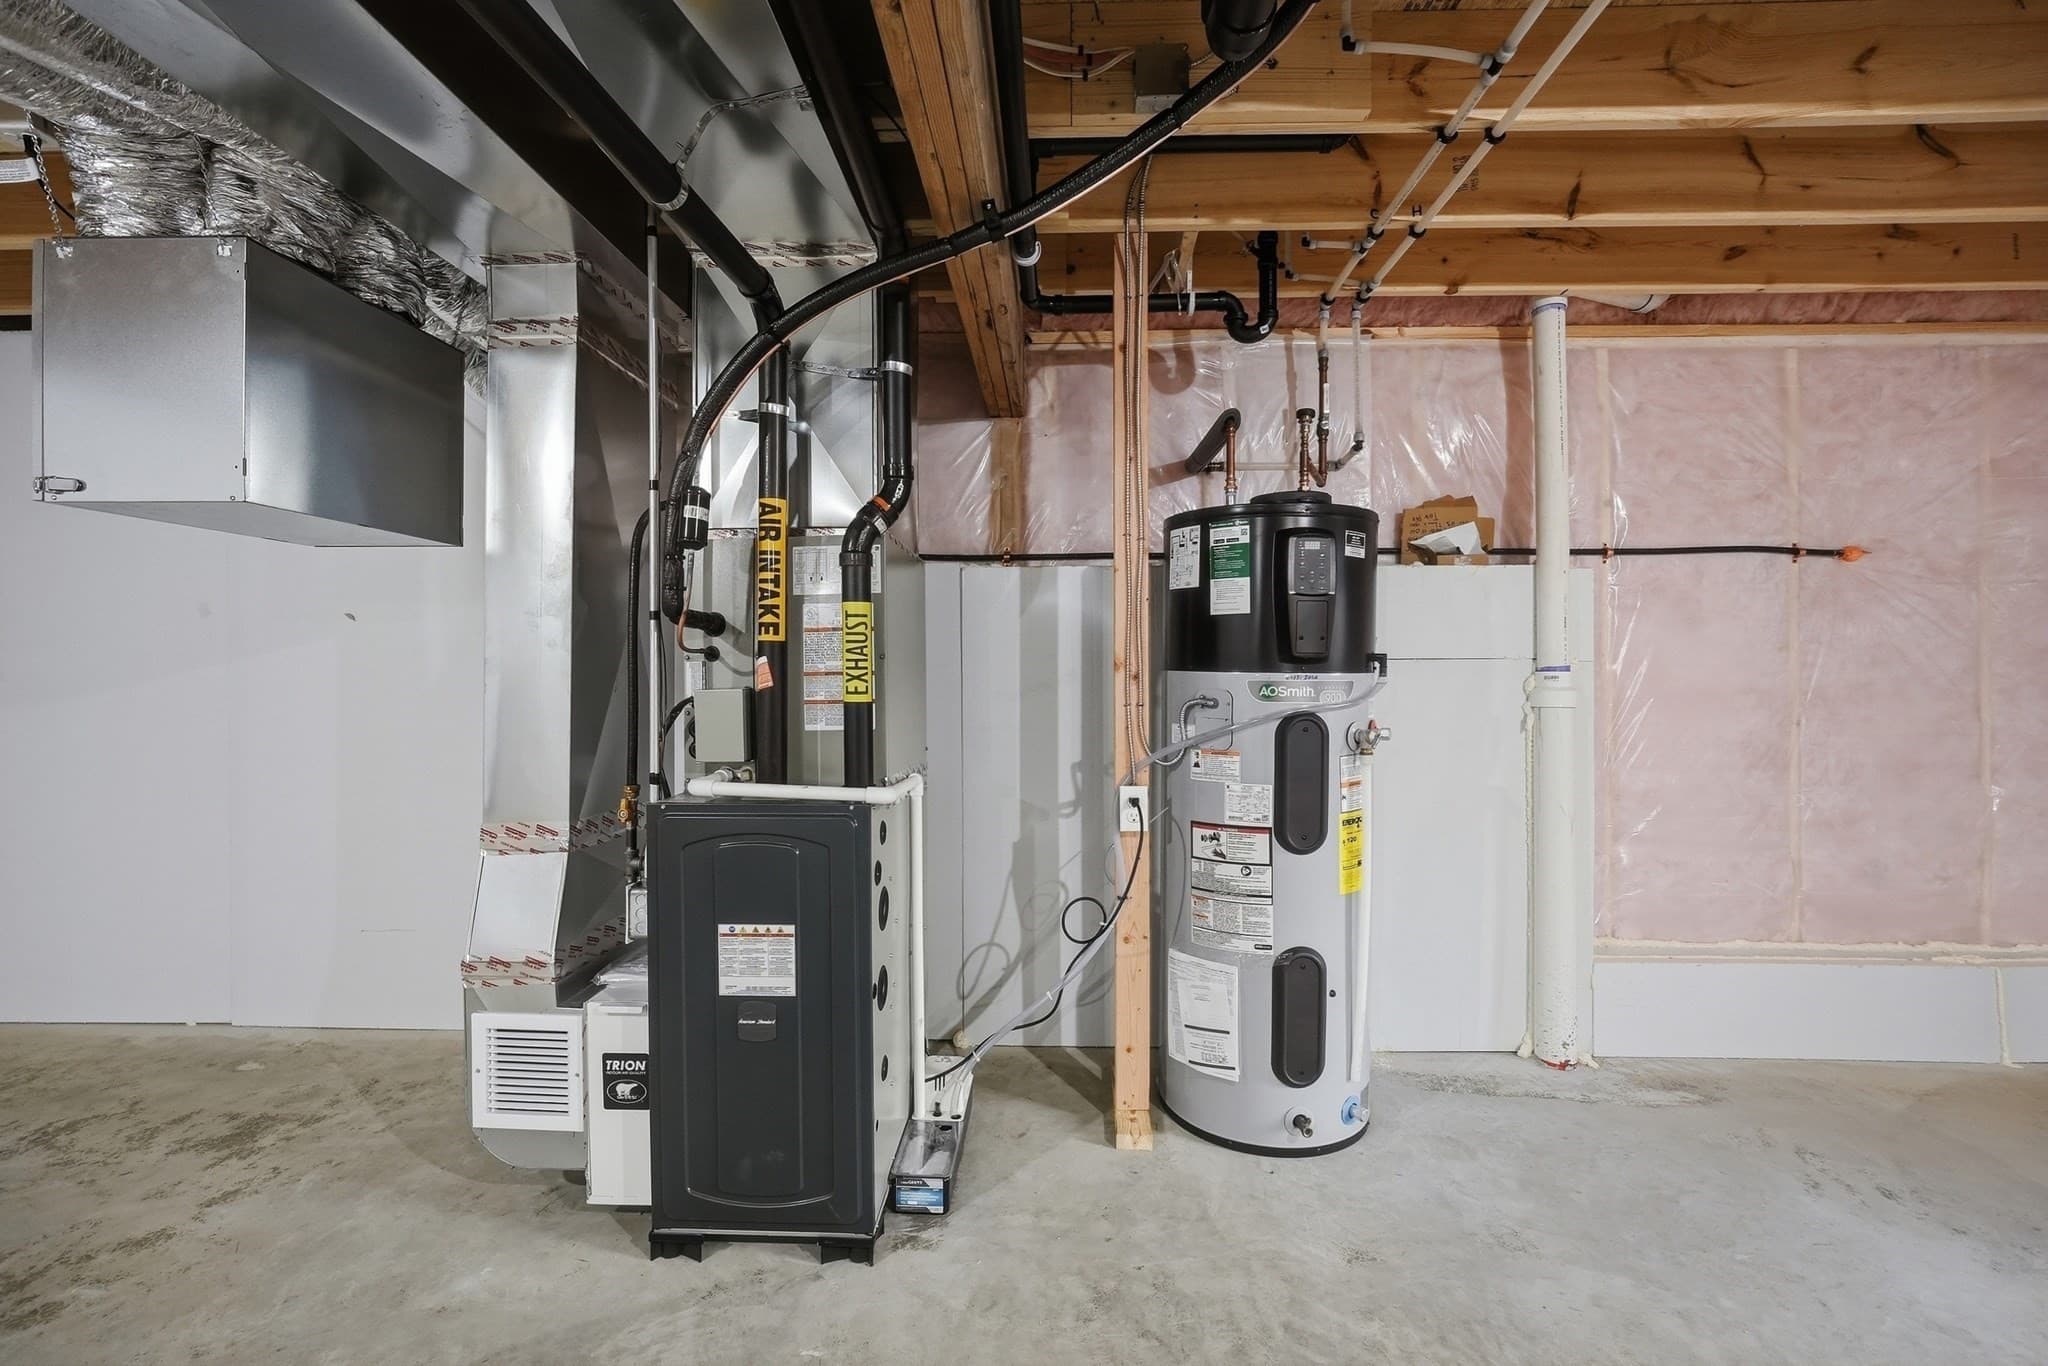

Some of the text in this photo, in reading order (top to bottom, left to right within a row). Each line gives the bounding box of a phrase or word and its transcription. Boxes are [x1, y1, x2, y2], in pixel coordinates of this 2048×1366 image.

[1412, 205, 1422, 217] H
[759, 501, 782, 636] AIR INTAKE
[845, 610, 868, 695] EXHAUST
[605, 1060, 646, 1071] TRION
